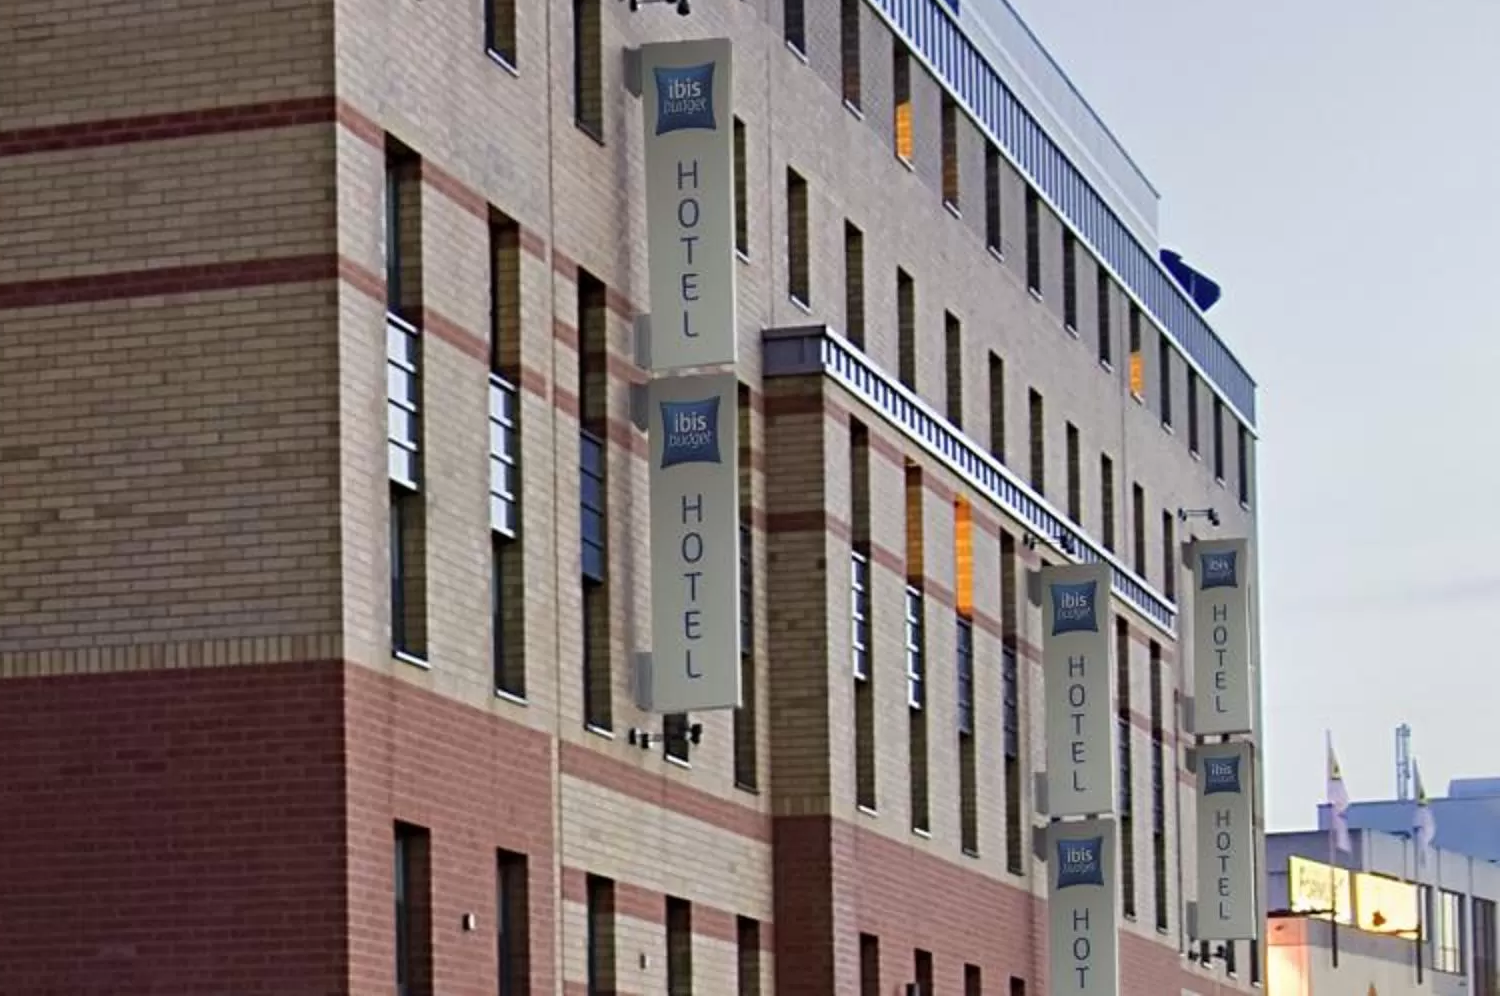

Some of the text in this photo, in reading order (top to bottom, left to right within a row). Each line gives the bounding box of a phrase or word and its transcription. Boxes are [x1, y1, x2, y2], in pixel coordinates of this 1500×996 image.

[668, 76, 701, 99] ibis
[677, 159, 700, 338] HOTEL
[675, 411, 707, 433] ibis
[681, 493, 703, 679] HOTEL
[1061, 591, 1088, 609] ibis
[1212, 604, 1229, 714] HOTEL
[1068, 655, 1087, 793] HOTEL
[1067, 847, 1093, 863] ibis
[1216, 810, 1232, 921] HOTEL
